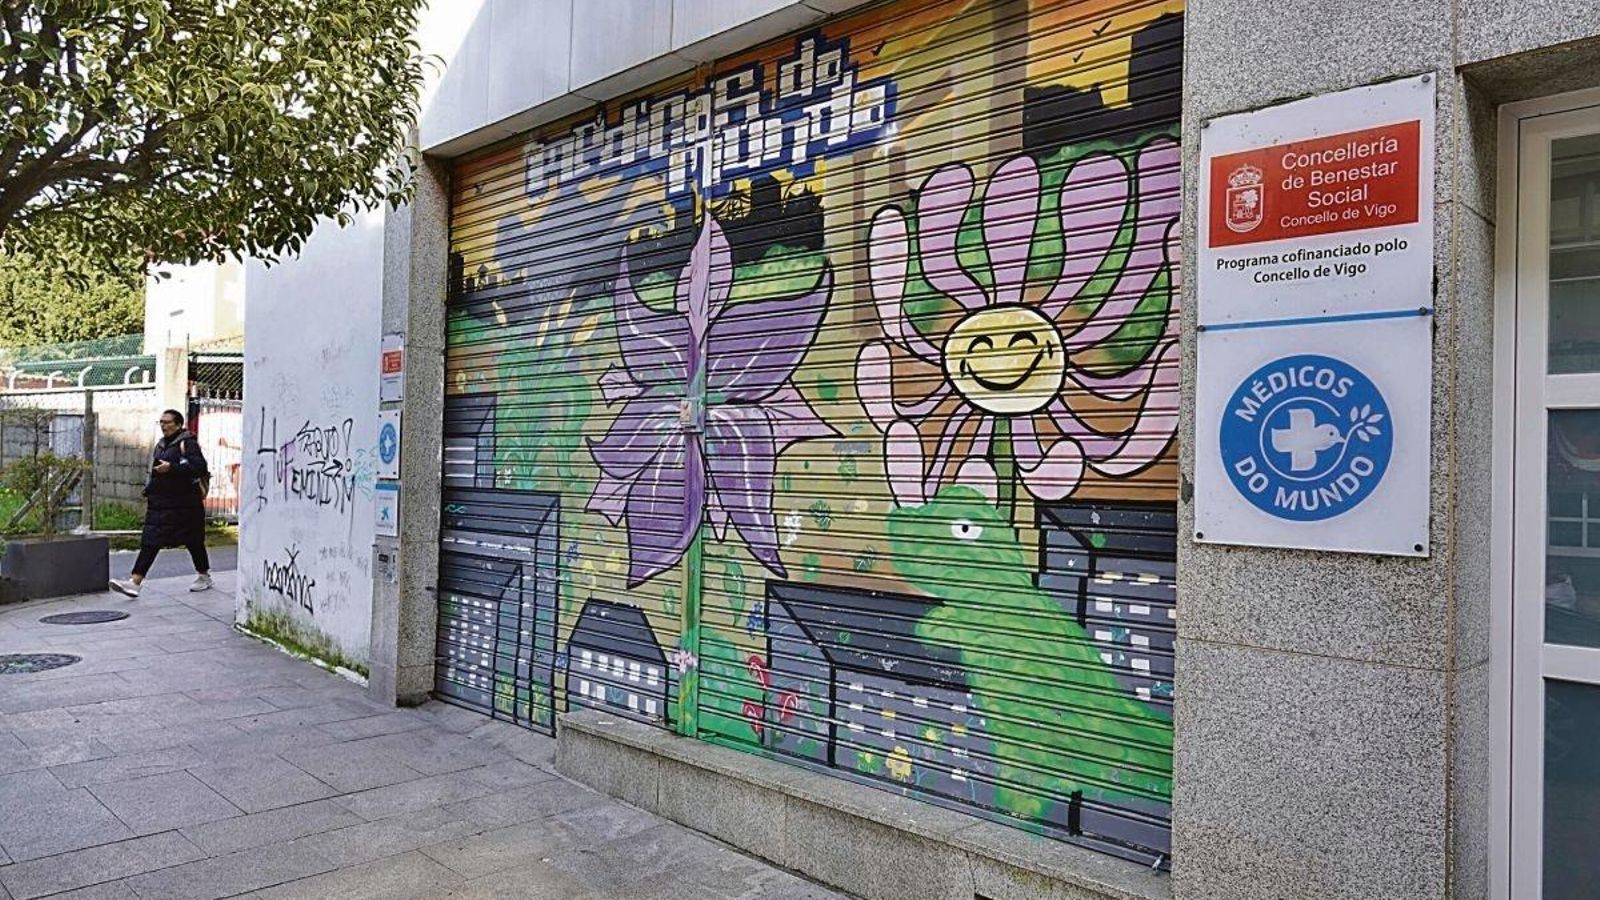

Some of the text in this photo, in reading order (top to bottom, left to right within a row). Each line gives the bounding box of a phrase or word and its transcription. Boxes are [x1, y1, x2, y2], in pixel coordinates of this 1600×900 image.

[1281, 136, 1398, 170] Concellería
[1281, 160, 1399, 190] de Benestar
[1307, 184, 1369, 208] Social
[1280, 203, 1397, 229] Concello de Vigo
[1216, 238, 1408, 271] Programa cofinanciado polo
[1253, 261, 1367, 284] Concello de Vigo
[1234, 365, 1355, 423] MÉDICOS
[1234, 455, 1375, 512] DO MUNDO
